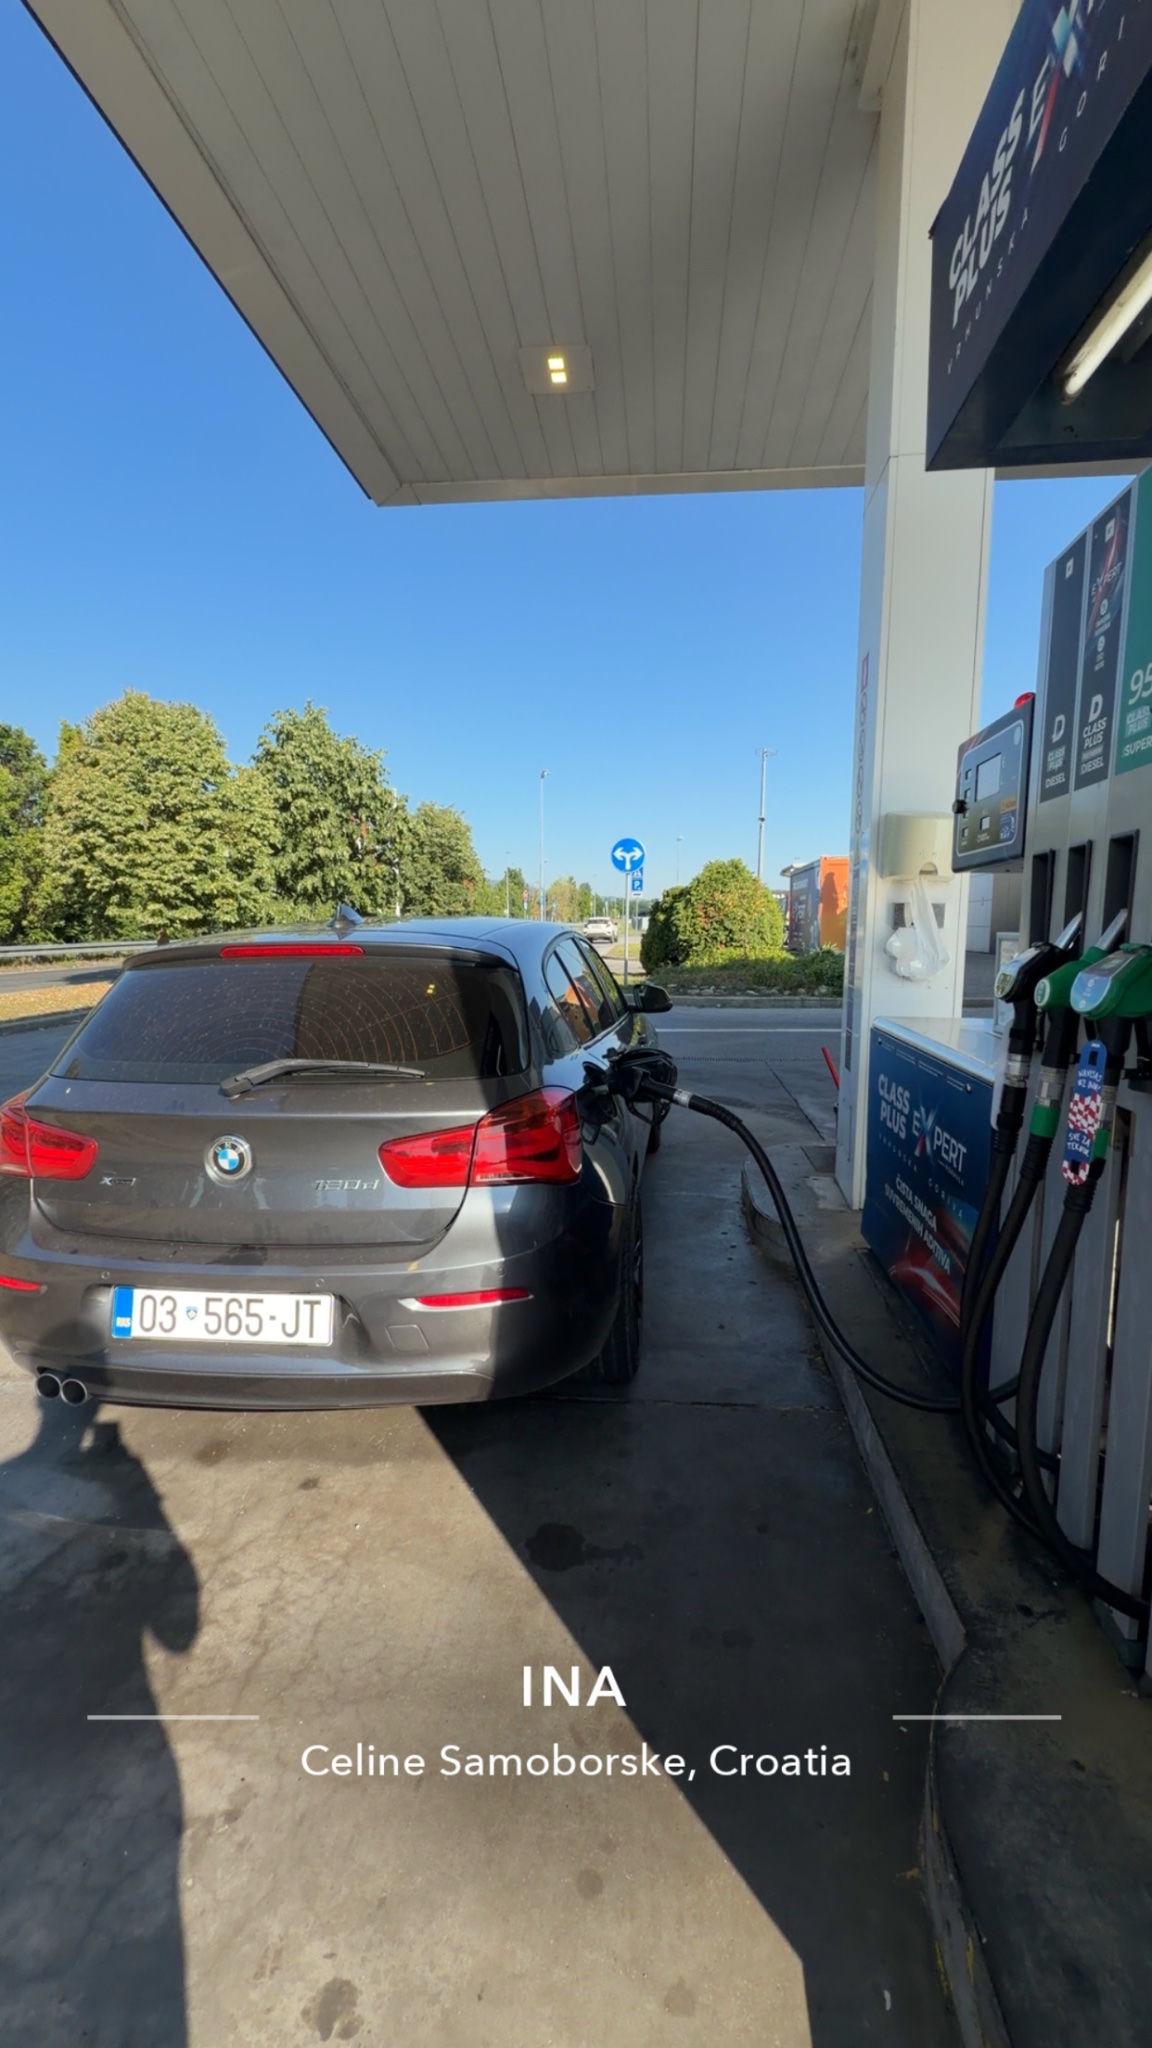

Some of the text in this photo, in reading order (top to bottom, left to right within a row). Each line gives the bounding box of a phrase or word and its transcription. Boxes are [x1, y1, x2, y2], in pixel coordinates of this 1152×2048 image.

[949, 88, 1025, 290] CLASS
[953, 165, 1013, 330] PLUS
[1089, 694, 1103, 722] D
[1052, 714, 1065, 743] D
[1083, 717, 1107, 738] CLASS
[1084, 731, 1103, 749] PLUS
[1045, 772, 1066, 788] DIESEL
[1080, 756, 1104, 775] DIESEL
[879, 1073, 967, 1173] CLASS EXPERT
[880, 1100, 907, 1139] PLUS
[139, 1294, 321, 1338] 03 565-JT
